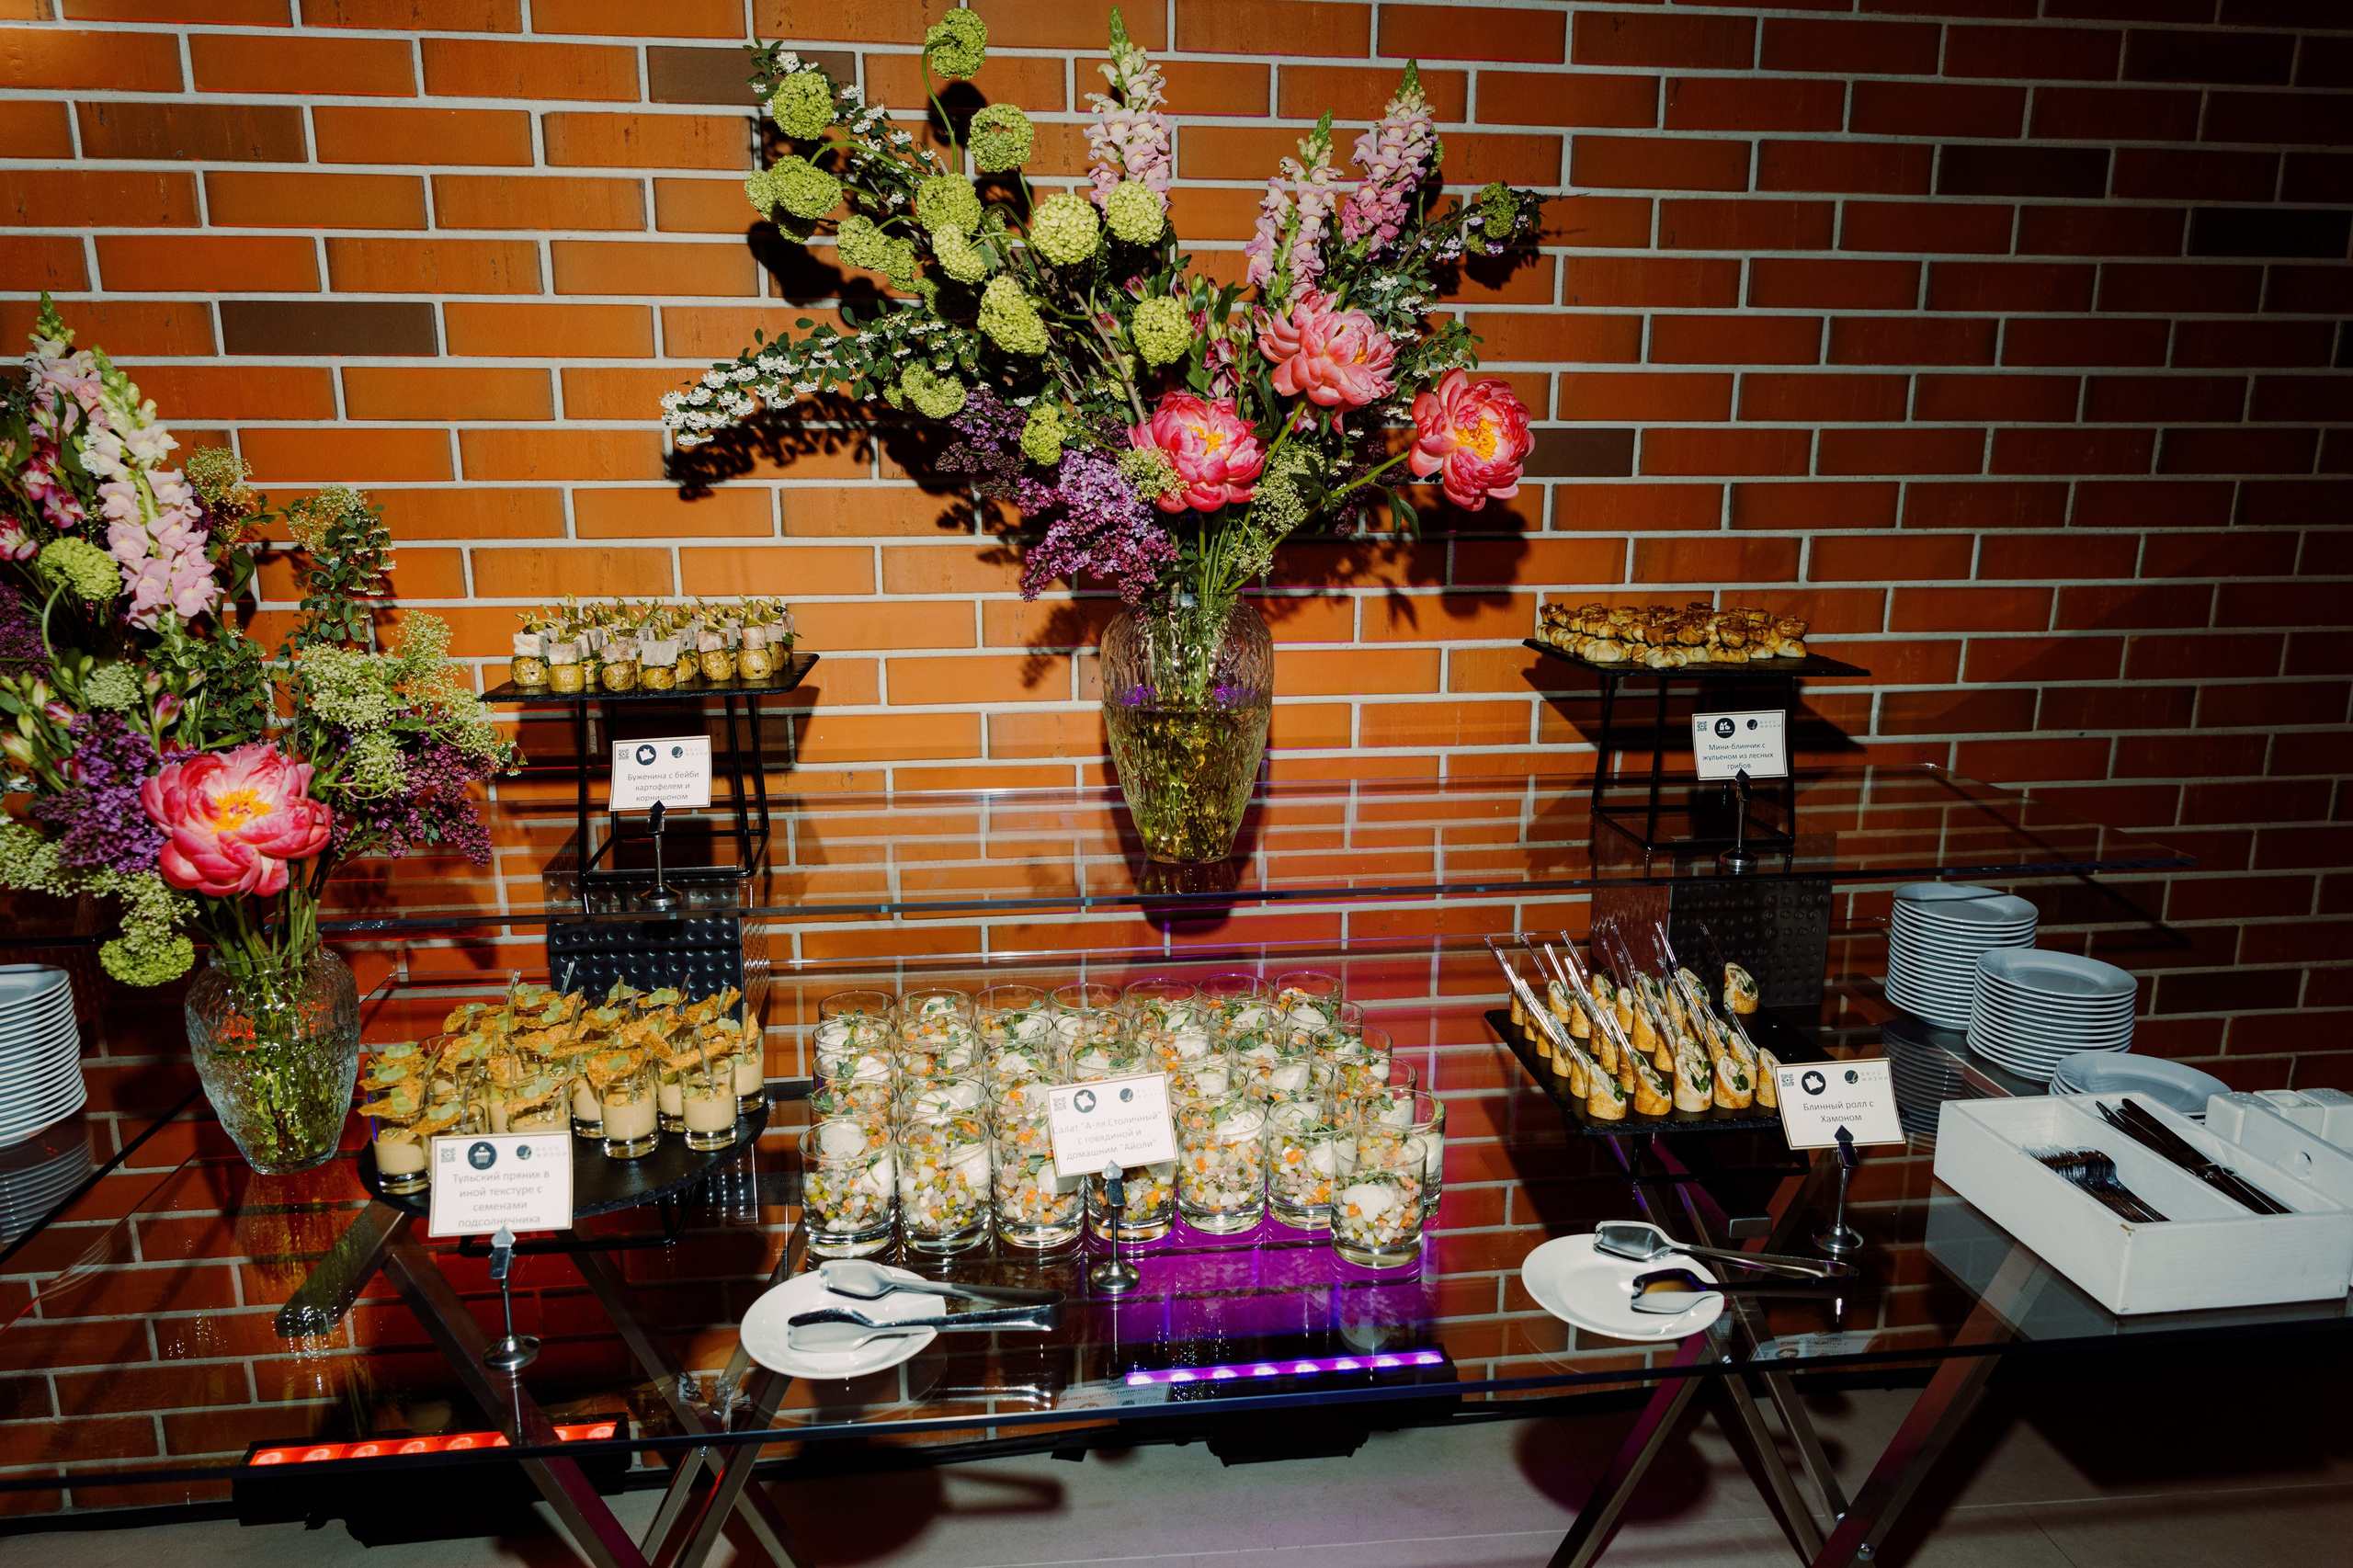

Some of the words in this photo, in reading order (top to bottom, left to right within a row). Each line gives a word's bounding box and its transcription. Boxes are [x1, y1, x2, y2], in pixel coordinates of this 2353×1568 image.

[1803, 1101, 1844, 1111] Блинный
[1846, 1101, 1867, 1110] ролл
[1052, 1124, 1078, 1135] Салат
[1108, 1111, 1162, 1126] Столичный"
[1821, 1114, 1862, 1123] Хамоном
[1085, 1129, 1134, 1143] говядиной
[1067, 1145, 1118, 1161] домашним
[1120, 1138, 1156, 1152] "Айоли"
[453, 1171, 500, 1185] Тульский
[503, 1172, 541, 1182] пряник
[460, 1187, 486, 1198] иной
[489, 1187, 534, 1196] текстуре
[473, 1203, 527, 1212] семенами
[458, 1216, 540, 1228] подсолнечника
